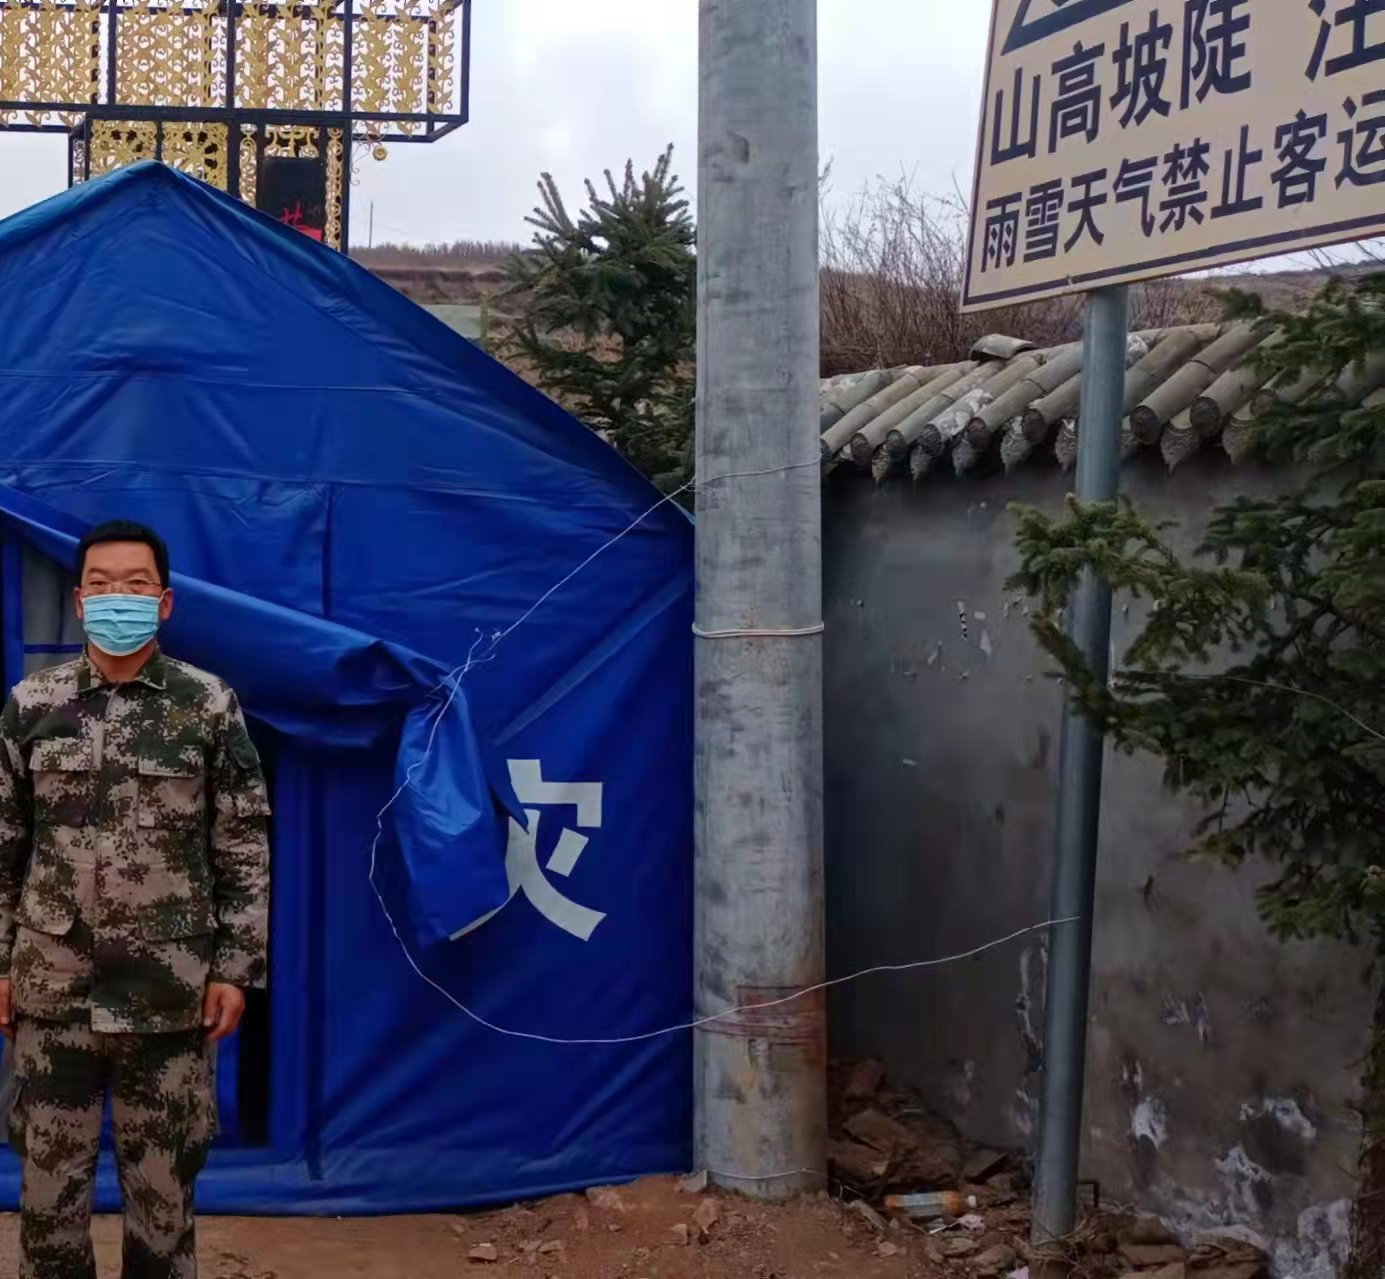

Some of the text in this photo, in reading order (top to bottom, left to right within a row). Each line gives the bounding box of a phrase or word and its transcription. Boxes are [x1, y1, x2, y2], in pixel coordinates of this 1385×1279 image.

[990, 0, 1251, 167] 山高坡陡
[981, 89, 1385, 273] 雨雪天气禁止客运
